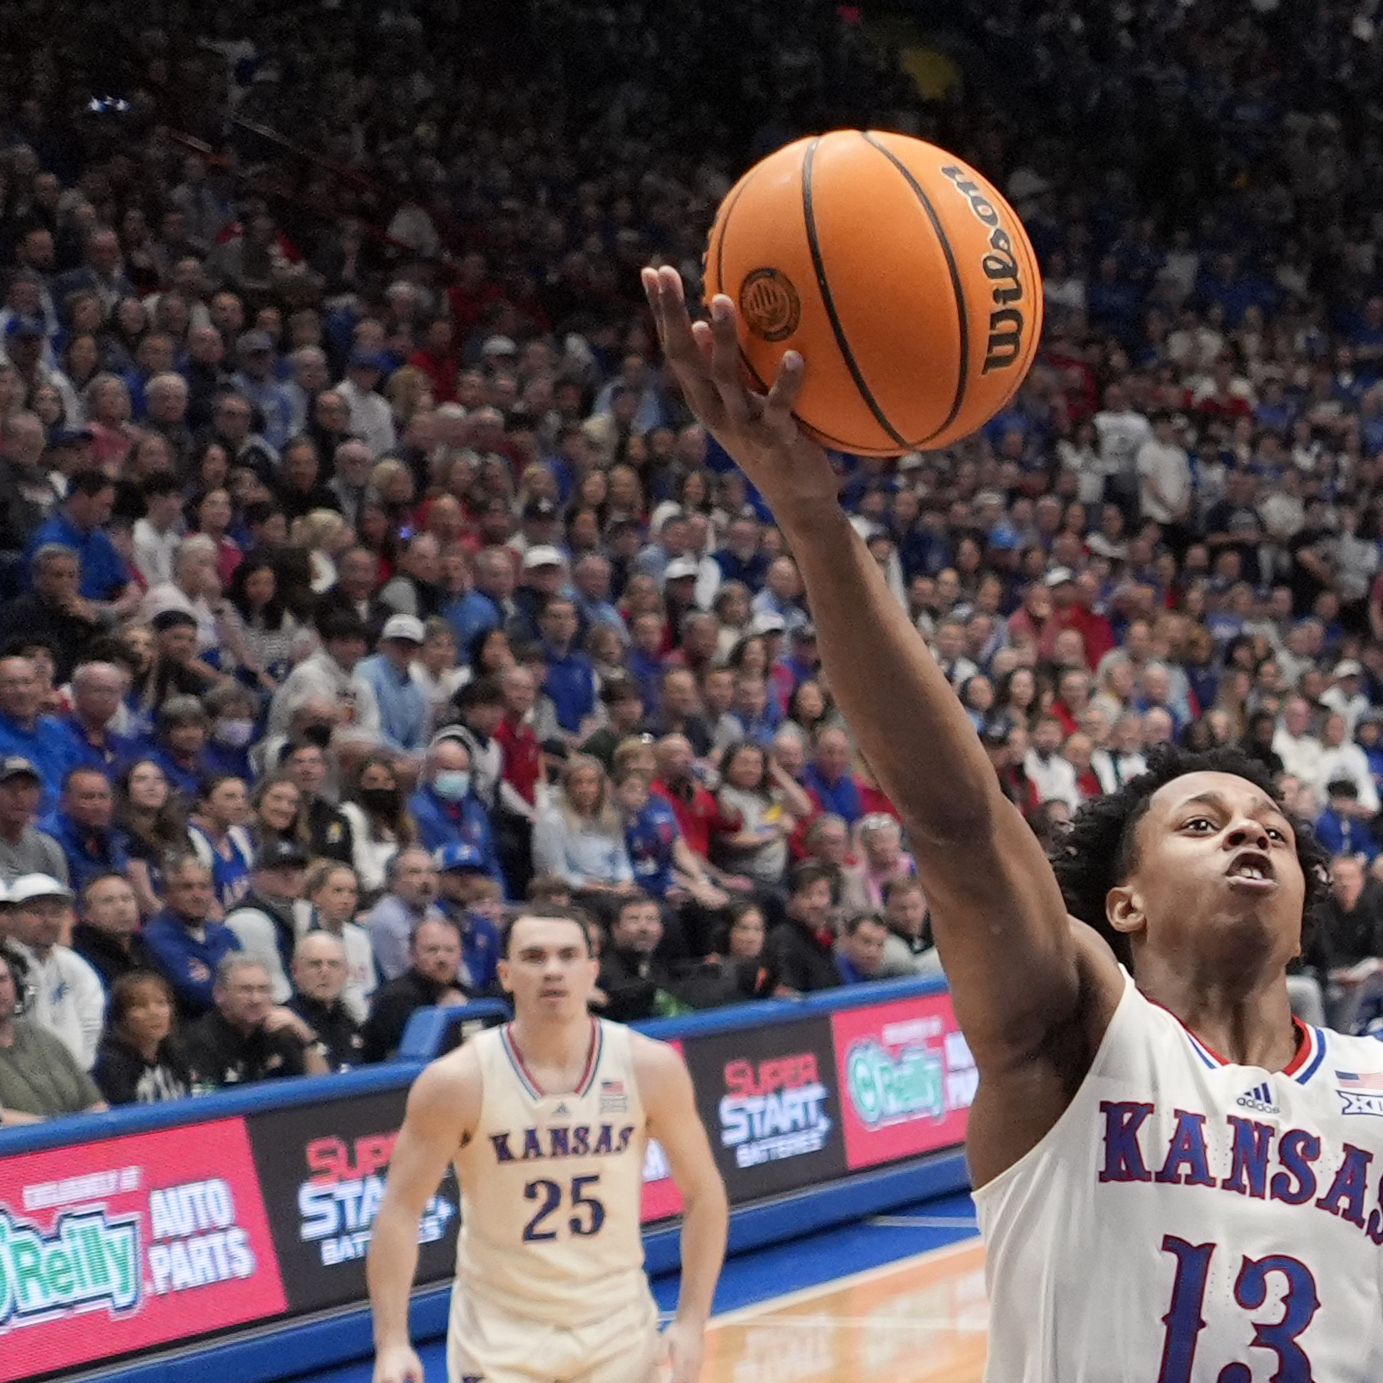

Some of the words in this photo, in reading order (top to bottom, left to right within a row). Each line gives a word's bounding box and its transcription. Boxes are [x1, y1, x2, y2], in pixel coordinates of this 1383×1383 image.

[941, 163, 1025, 378] Wilson
[306, 1129, 400, 1187] SUP
[489, 1125, 635, 1164] KANSAS
[149, 1178, 235, 1240] AUTO
[522, 1174, 606, 1244] 25
[149, 1226, 256, 1296] PARTS
